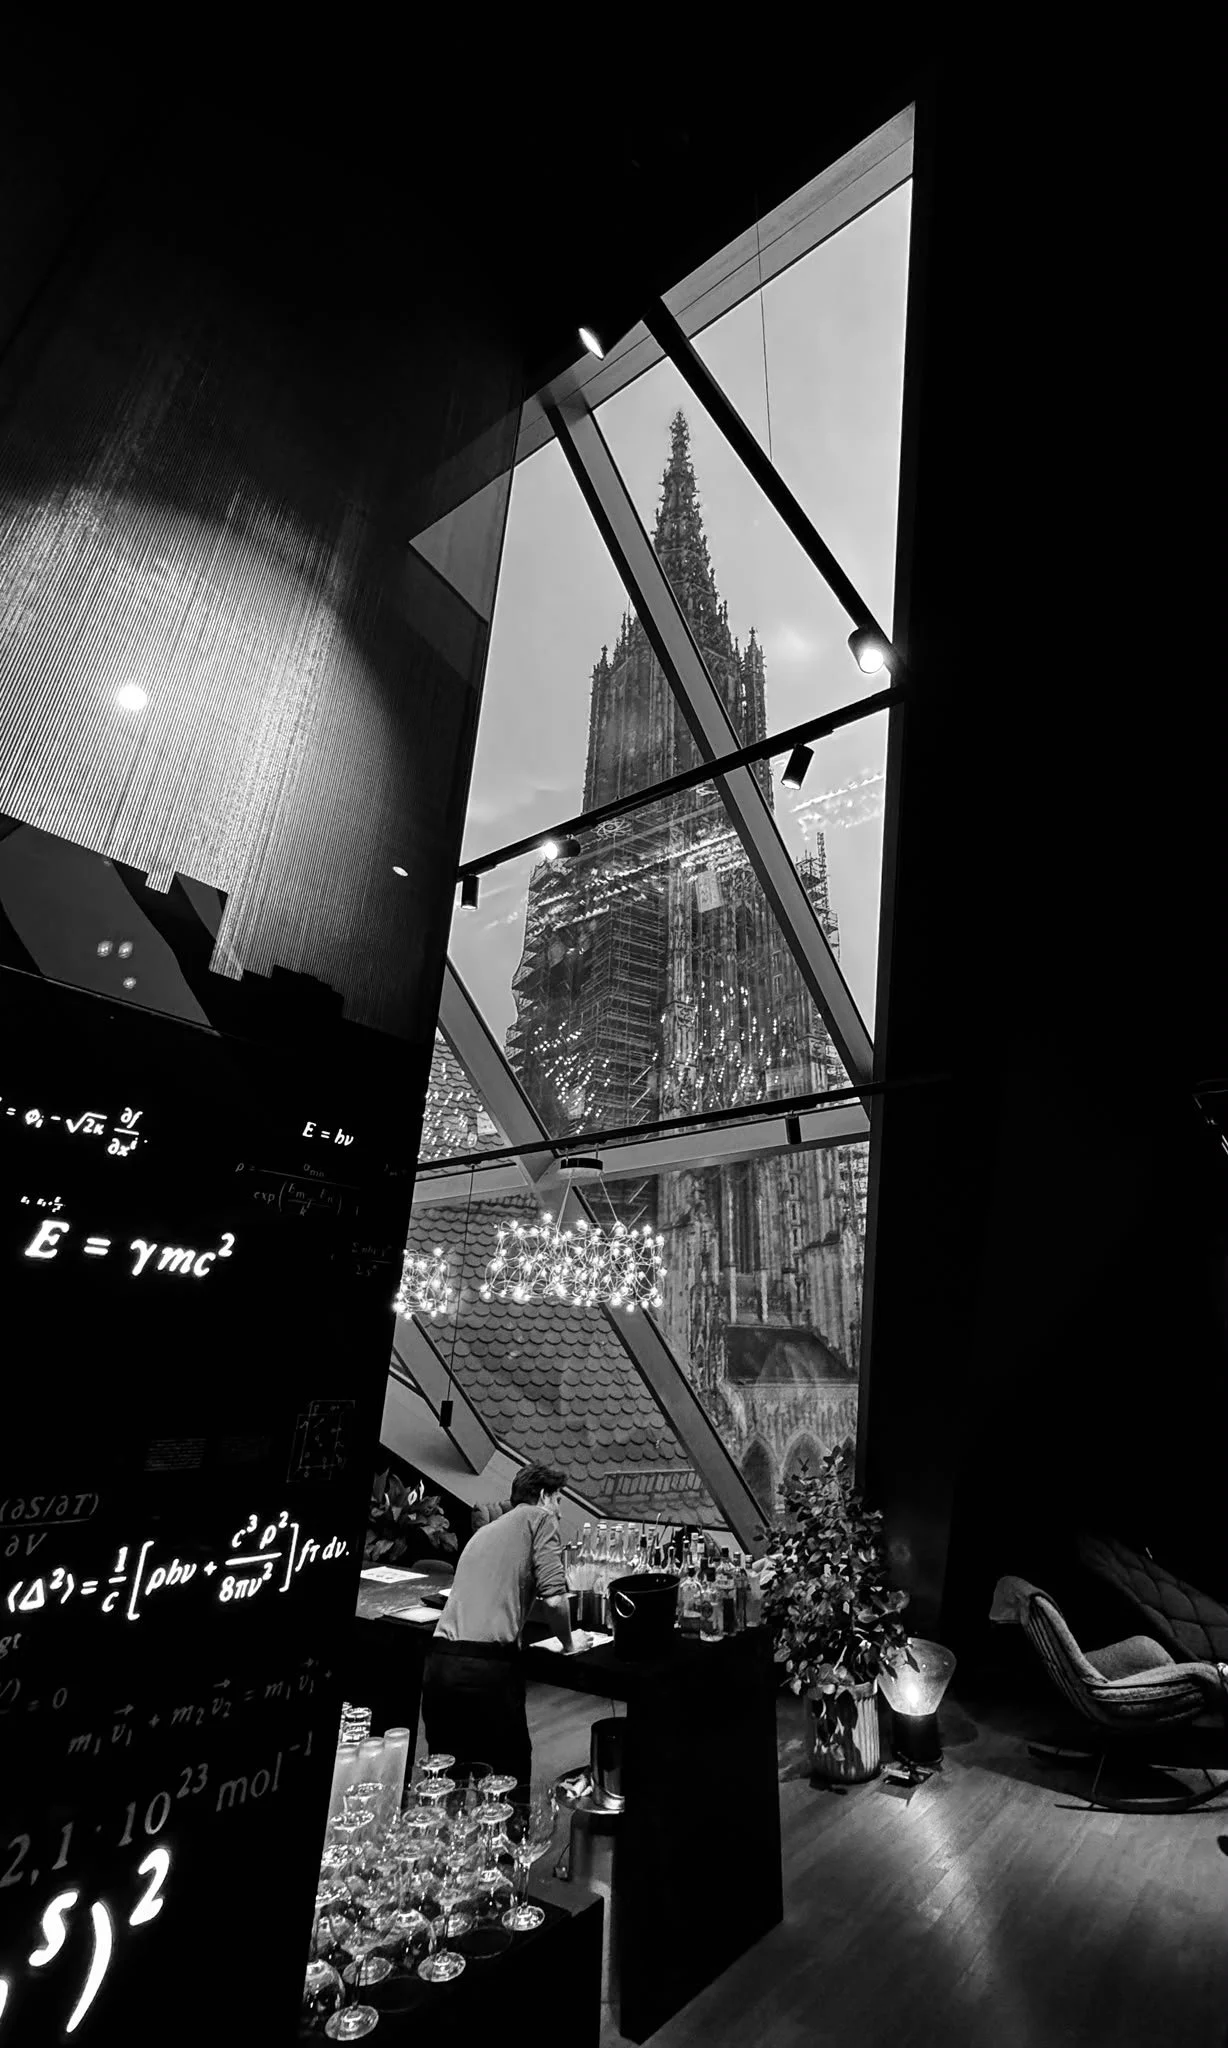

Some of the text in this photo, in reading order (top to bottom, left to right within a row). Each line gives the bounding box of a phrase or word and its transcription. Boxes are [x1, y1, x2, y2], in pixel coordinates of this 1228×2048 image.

[302, 1121, 317, 1138] E
[320, 1130, 331, 1139] =
[24, 1219, 70, 1259] E
[83, 1237, 111, 1256] =
[203, 1560, 218, 1577] +
[80, 1580, 99, 1596] =
[148, 1713, 161, 1728] +
[243, 1688, 257, 1701] =
